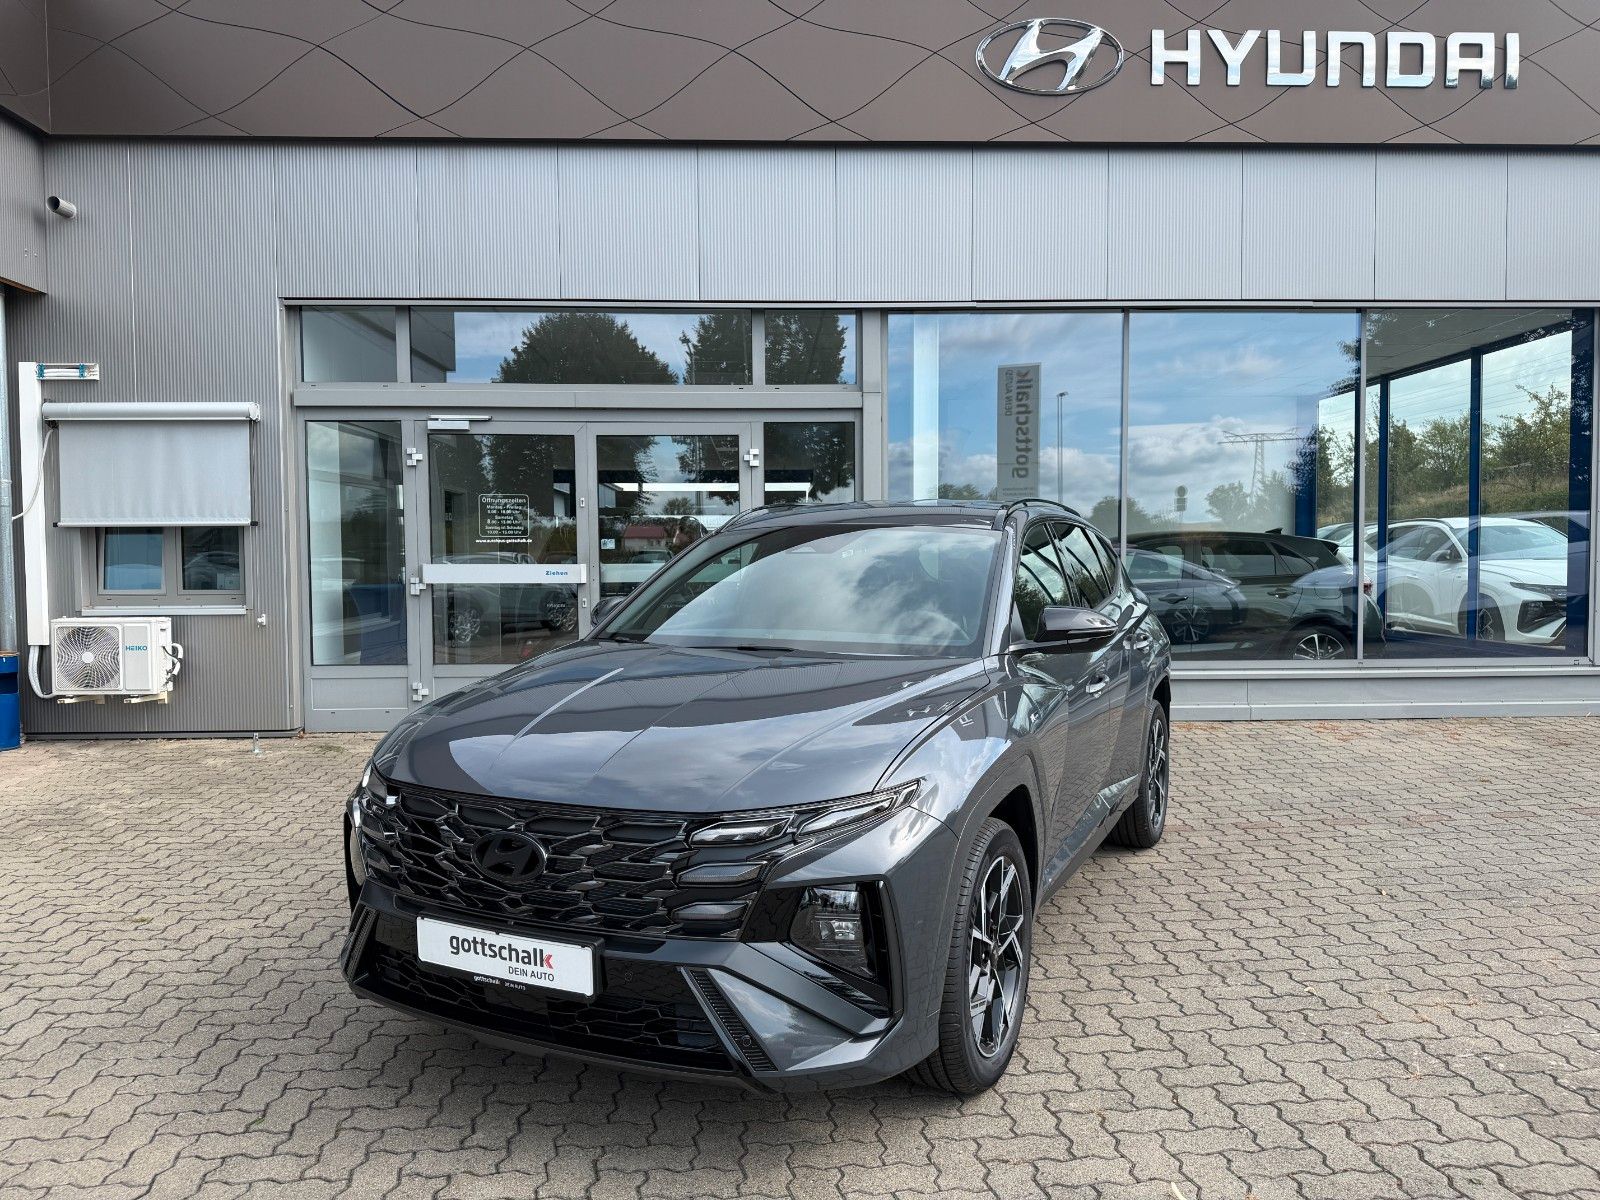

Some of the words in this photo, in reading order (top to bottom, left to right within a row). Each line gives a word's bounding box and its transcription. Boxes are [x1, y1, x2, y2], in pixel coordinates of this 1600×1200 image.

[1150, 29, 1520, 89] HYUNDAI
[449, 935, 554, 969] gottschalk
[508, 965, 528, 977] DEIN
[530, 970, 555, 982] AUTO
